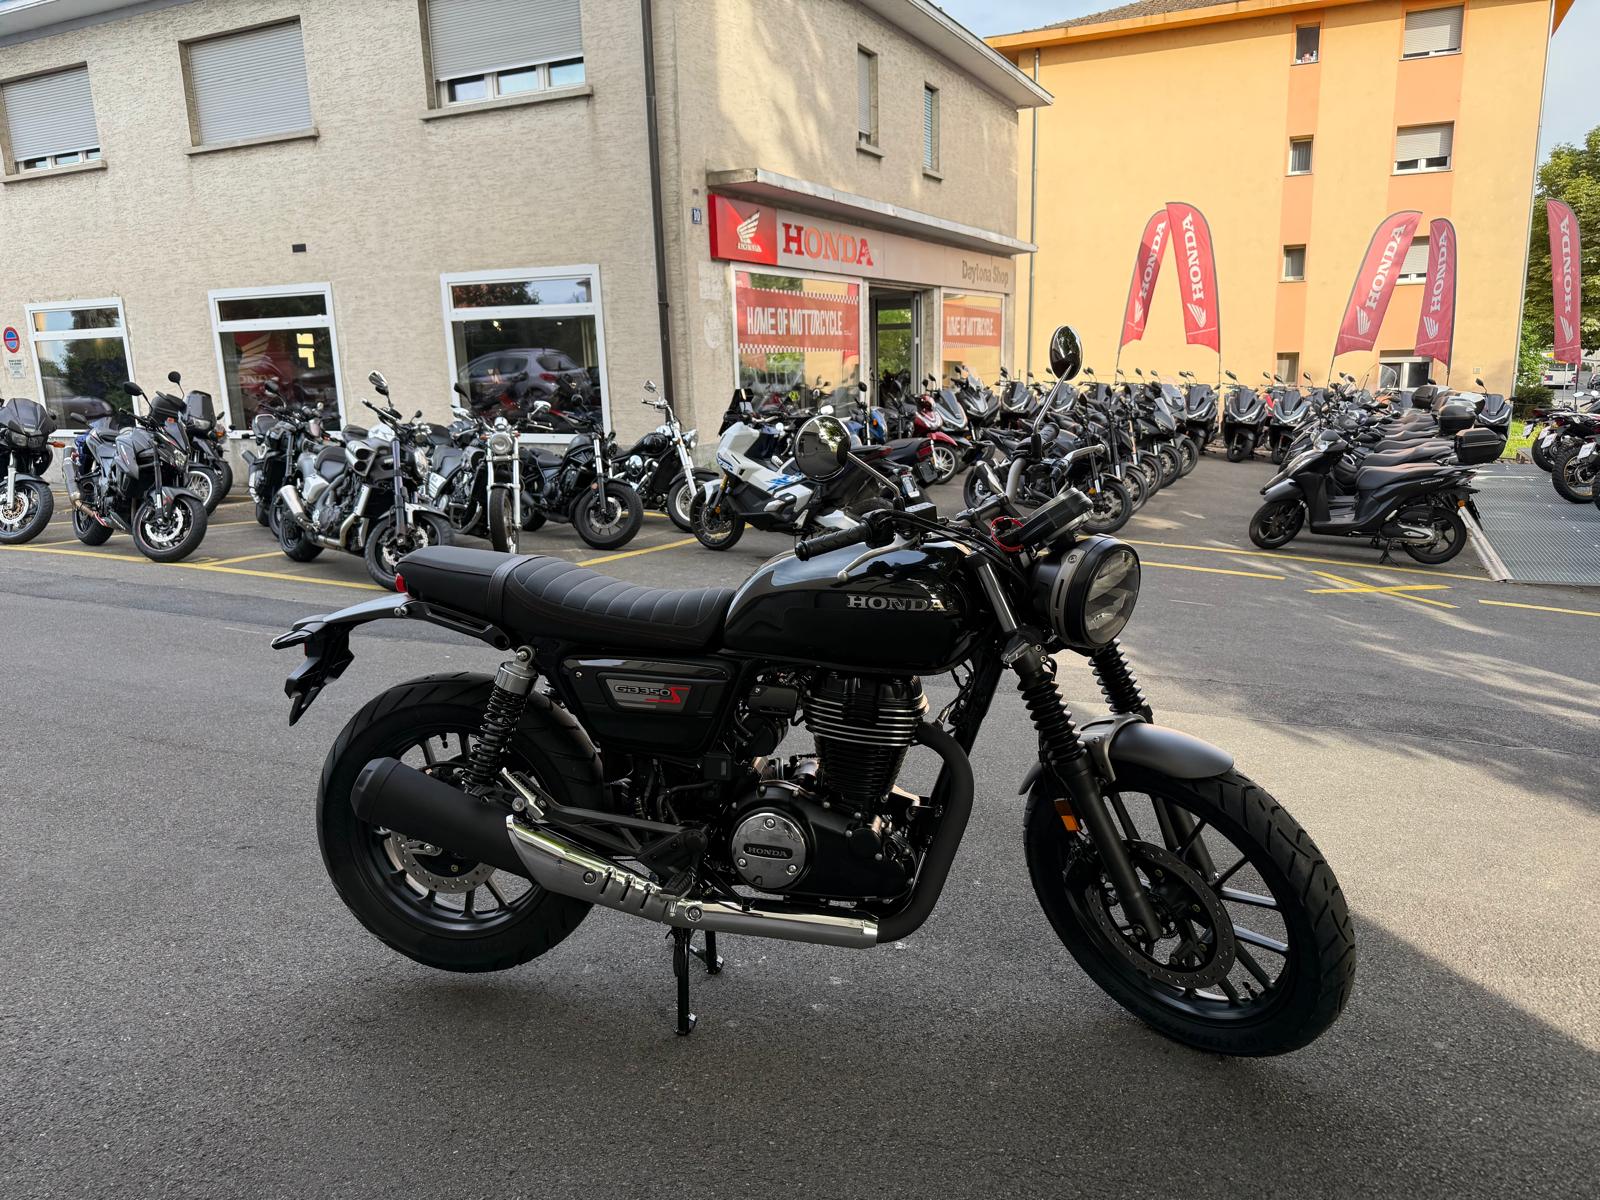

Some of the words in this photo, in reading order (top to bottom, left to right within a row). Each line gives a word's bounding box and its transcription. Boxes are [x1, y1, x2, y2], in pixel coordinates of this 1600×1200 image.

[782, 222, 874, 266] HONDA
[962, 260, 991, 284] Daytona
[992, 265, 1009, 288] Shop
[1139, 221, 1167, 299] HONDA
[1182, 212, 1205, 301] HONDA
[1365, 224, 1406, 310] HONDA
[1430, 227, 1448, 313] HONDA
[1560, 215, 1572, 314] HONDA
[746, 306, 776, 335] HOME
[777, 307, 788, 335] OF
[789, 307, 843, 336] MOTORCYCLE
[847, 595, 947, 612] HONDA
[747, 847, 788, 857] HONDA
